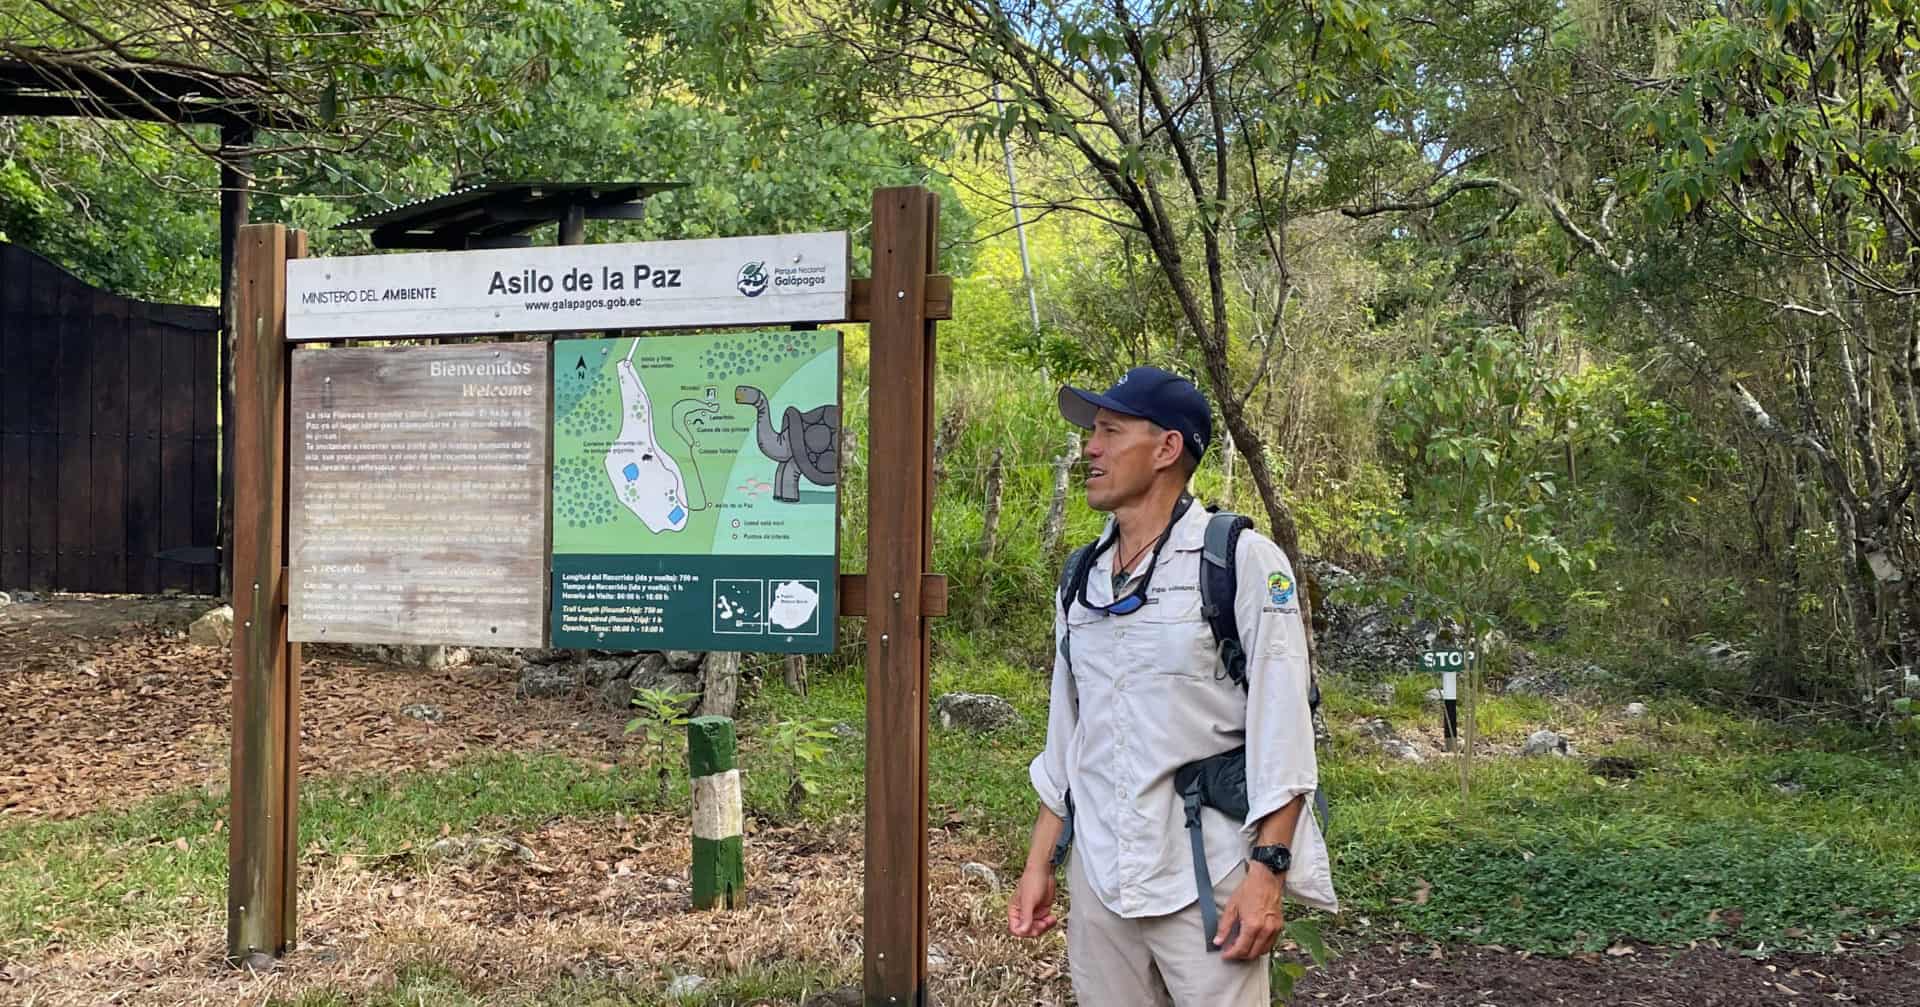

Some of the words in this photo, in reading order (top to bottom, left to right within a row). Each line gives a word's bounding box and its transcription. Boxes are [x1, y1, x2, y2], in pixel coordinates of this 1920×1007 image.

[774, 266, 798, 275] Parque
[798, 266, 826, 274] Nacional
[488, 269, 554, 295] Asilo
[562, 267, 593, 292] de
[603, 266, 624, 290] la
[634, 264, 682, 289] Paz
[302, 290, 358, 304] MINISTERIO
[360, 290, 378, 302] DEL
[382, 287, 437, 301] AMBIENTE
[525, 297, 641, 312] www.galapagos.gob.ec
[430, 360, 532, 377] Bienvenidos
[577, 371, 585, 380] N
[462, 383, 533, 397] Welcome
[1423, 651, 1475, 667] STOP
